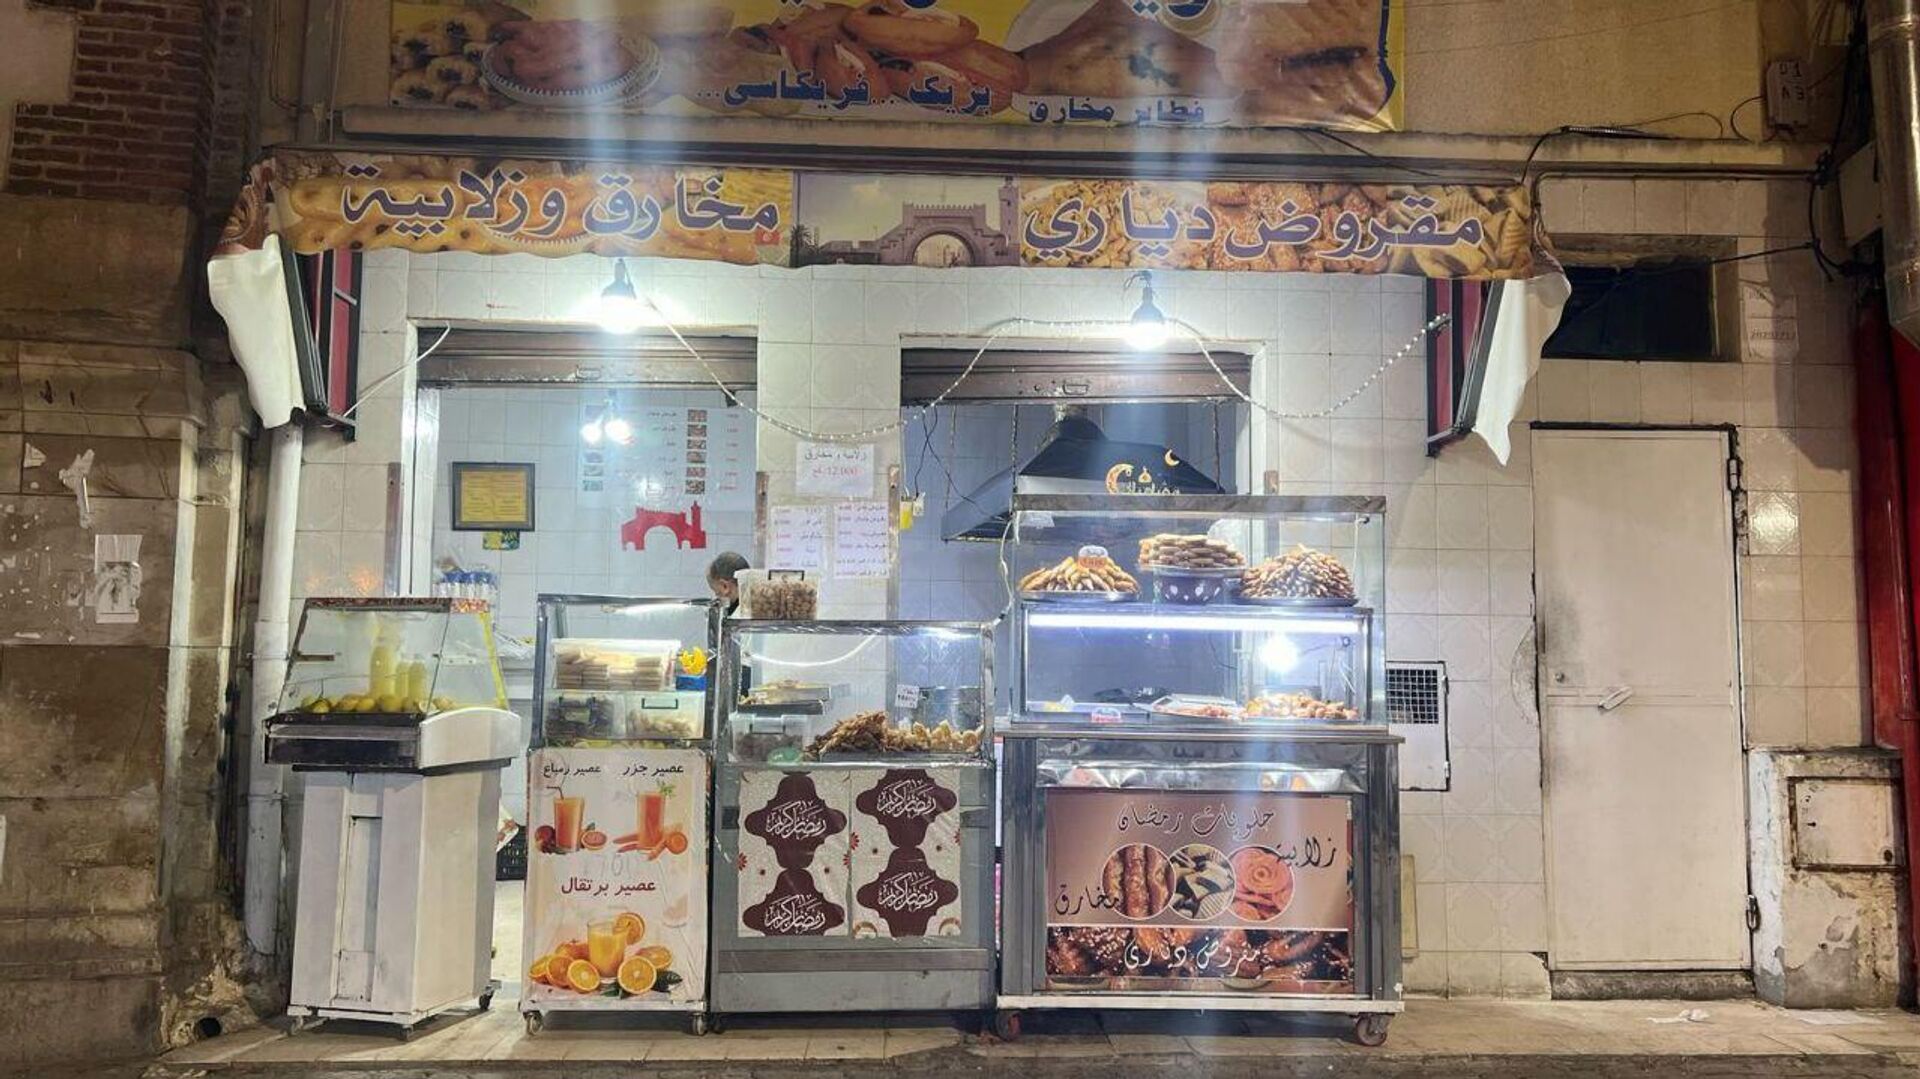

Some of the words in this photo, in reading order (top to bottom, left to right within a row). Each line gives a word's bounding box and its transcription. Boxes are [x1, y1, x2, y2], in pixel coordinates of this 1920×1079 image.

[908, 75, 992, 116] بريك
[1028, 97, 1115, 123] مخارق
[582, 172, 779, 244] مخارق
[1023, 188, 1216, 260] دياري
[1222, 195, 1484, 260] مقروض
[573, 765, 602, 778] عصير
[622, 765, 648, 778] جزر
[651, 765, 685, 778] عصير
[1118, 803, 1184, 834] رمضان
[614, 881, 656, 896] عصير
[1055, 884, 1120, 915] مخارق
